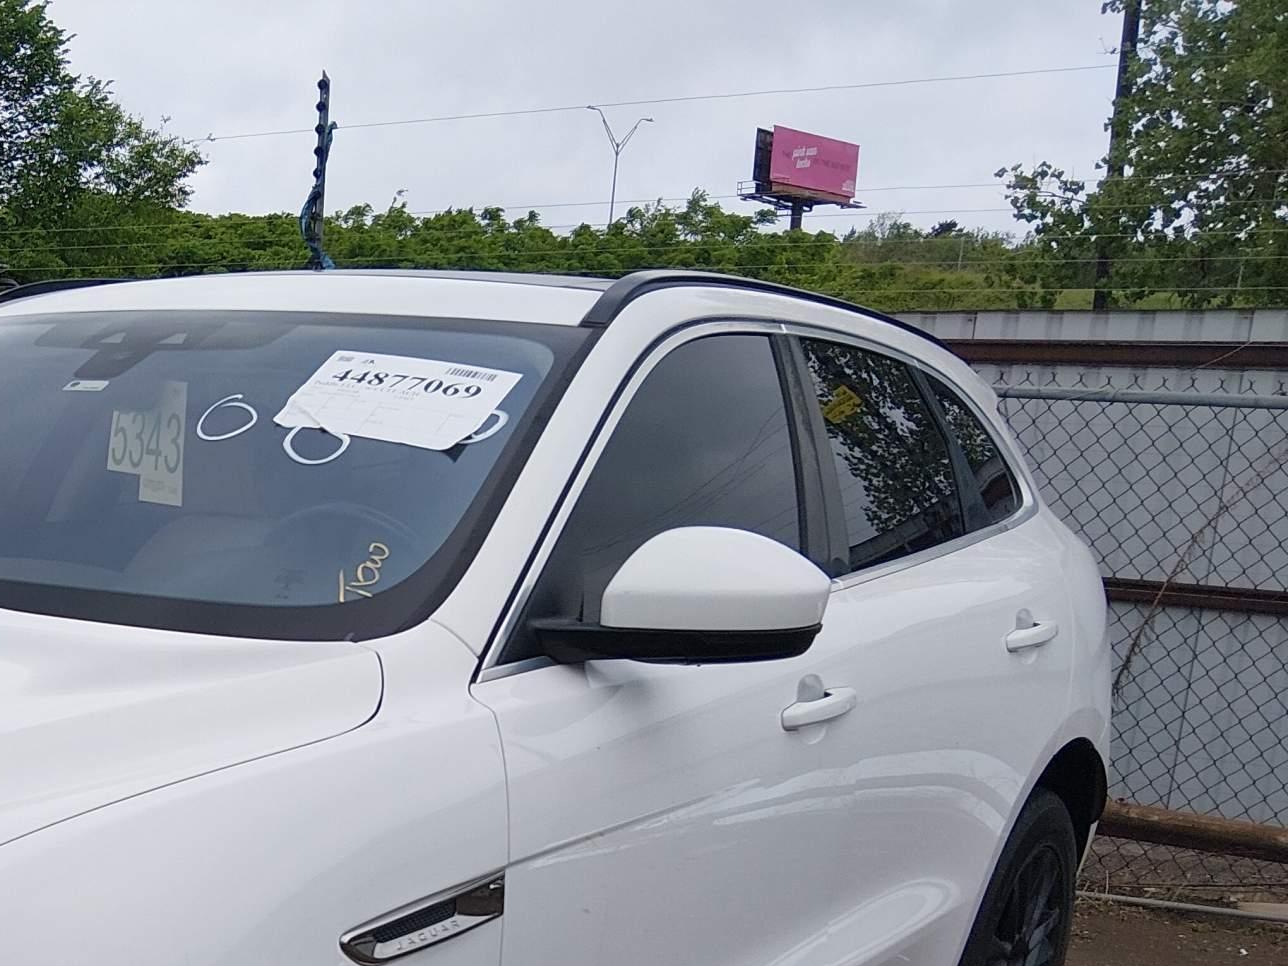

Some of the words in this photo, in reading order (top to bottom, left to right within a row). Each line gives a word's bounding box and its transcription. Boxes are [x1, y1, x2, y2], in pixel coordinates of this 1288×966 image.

[332, 368, 482, 399] 44877069
[112, 411, 182, 474] 5343
[396, 920, 460, 951] JAGUAR
